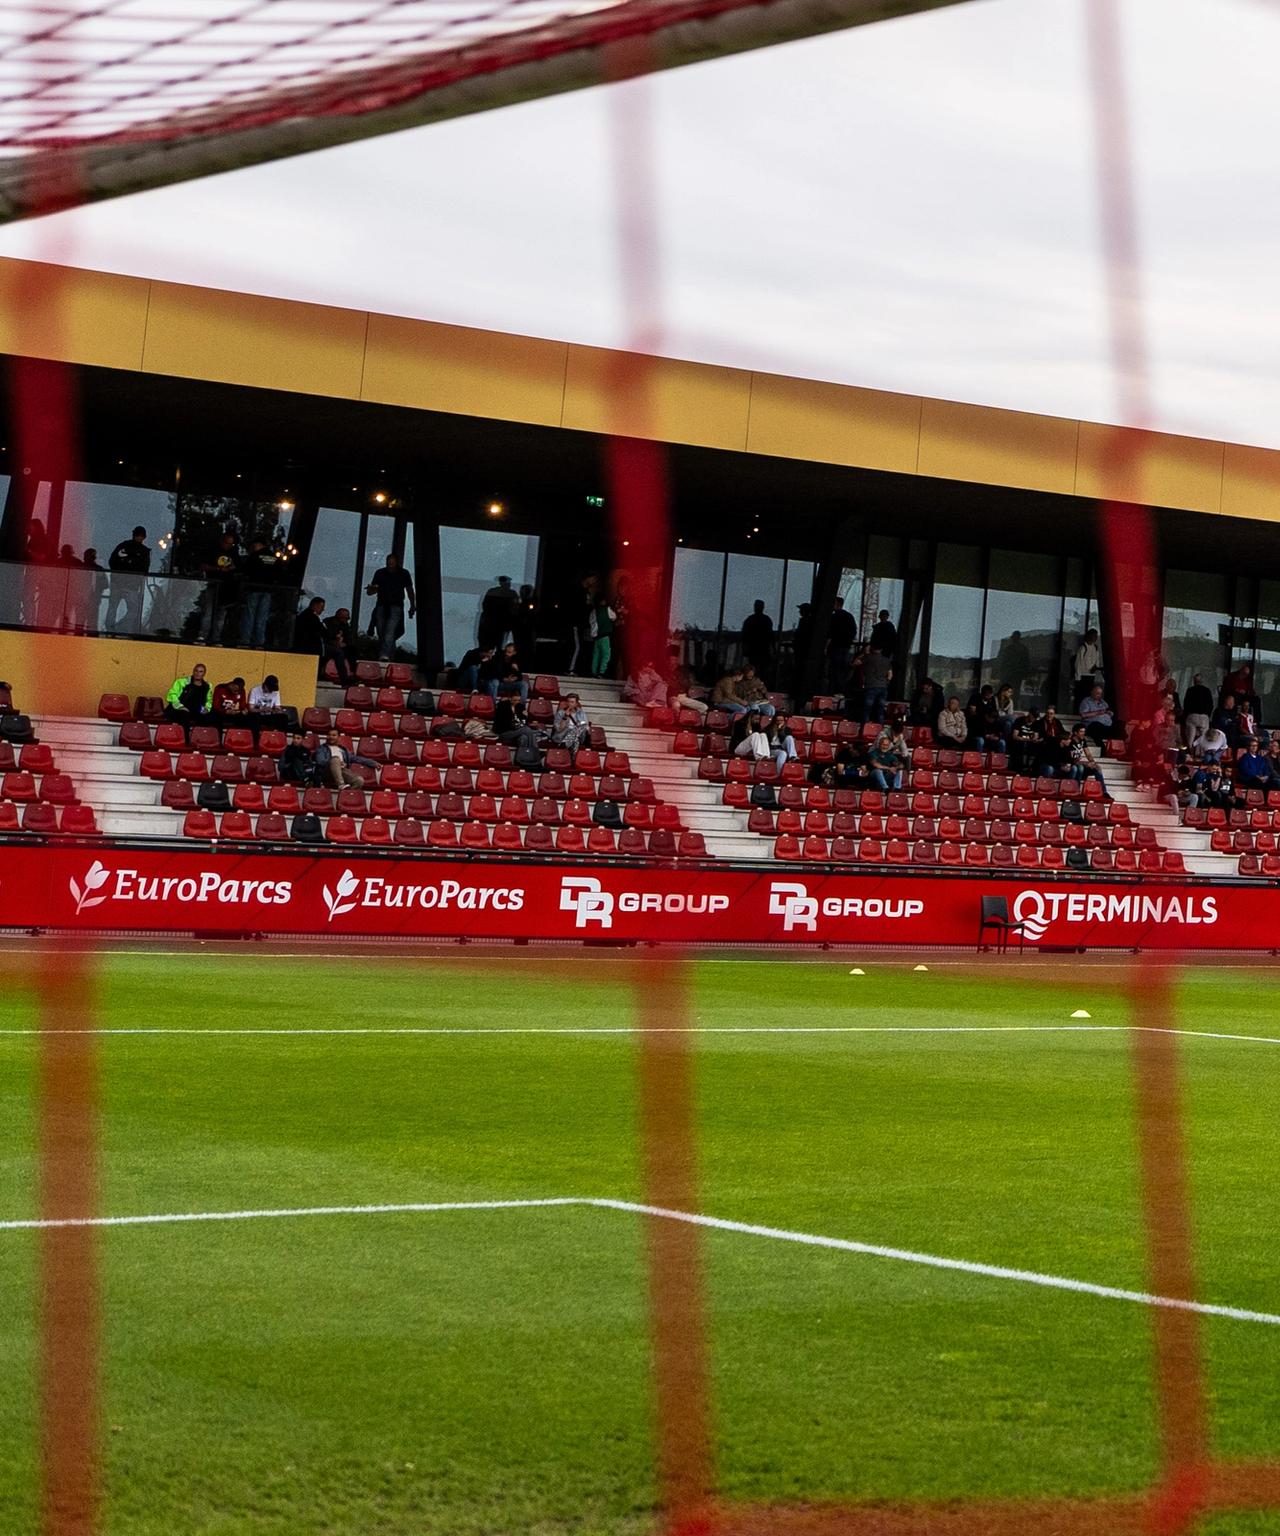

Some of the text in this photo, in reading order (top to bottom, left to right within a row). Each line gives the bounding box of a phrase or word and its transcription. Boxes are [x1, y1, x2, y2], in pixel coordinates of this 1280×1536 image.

[112, 870, 292, 904] EuroParcs
[361, 878, 524, 911] EuroParcs
[618, 892, 729, 913] GROUP
[822, 897, 923, 918] GROUP
[1013, 890, 1218, 930] QTERMINALS
